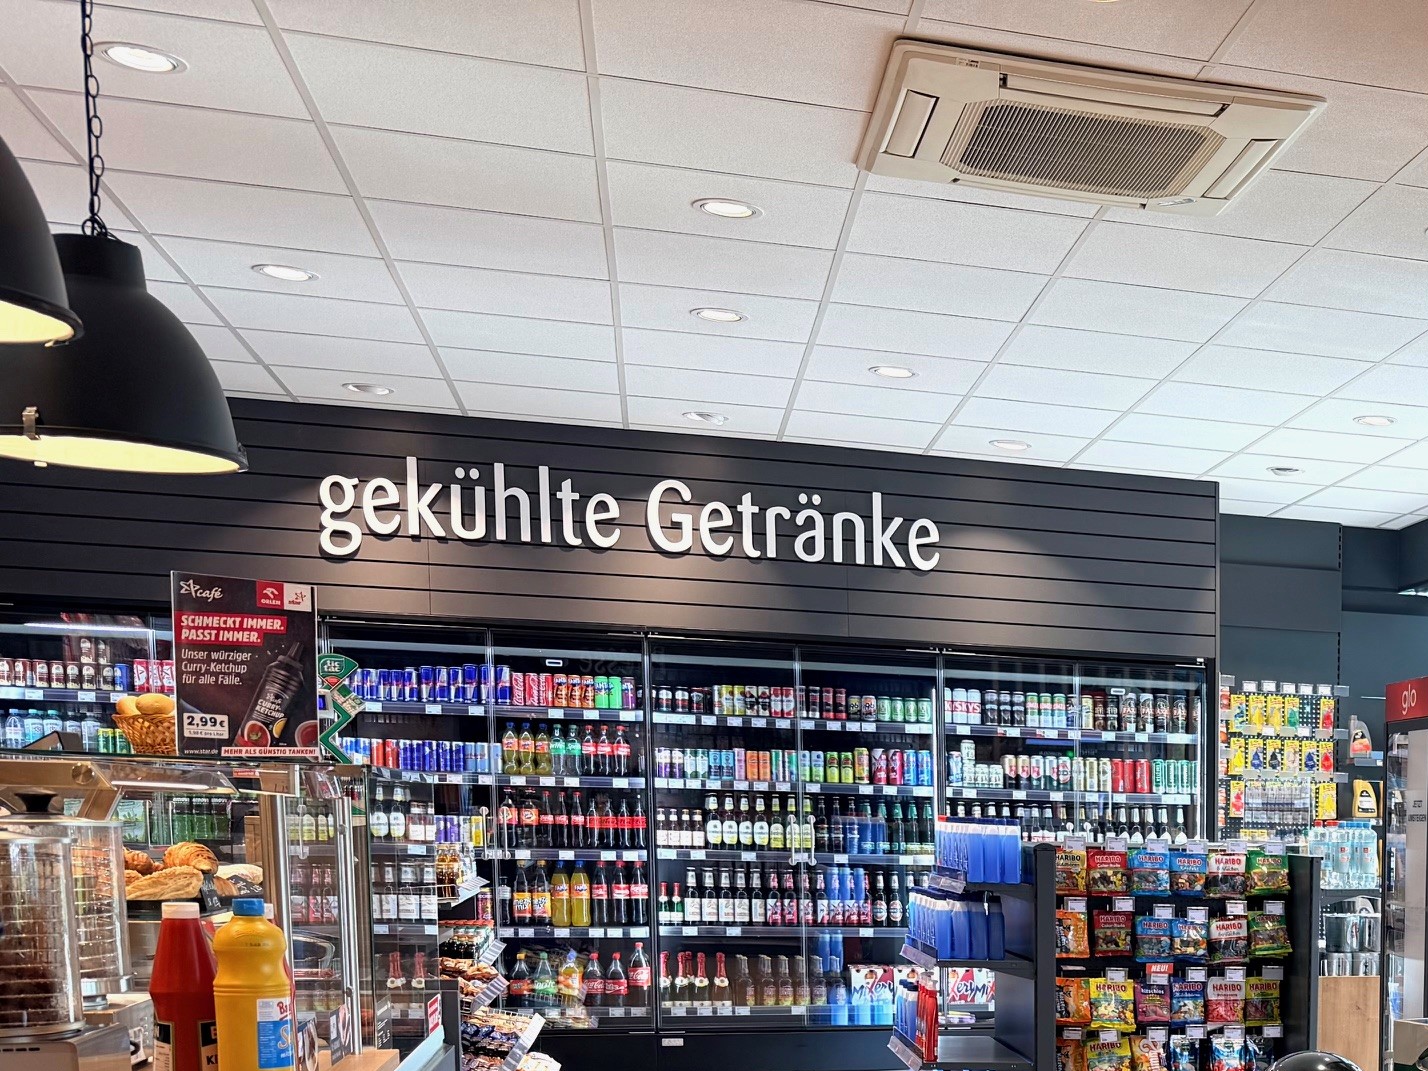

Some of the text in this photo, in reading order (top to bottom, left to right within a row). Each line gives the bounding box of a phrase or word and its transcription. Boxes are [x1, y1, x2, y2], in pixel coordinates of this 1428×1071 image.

[319, 456, 941, 570] gekühlte Getränke
[197, 587, 223, 602] café
[261, 598, 281, 606] ORLEN
[181, 615, 284, 630] SCHMECKT IMMER.
[181, 629, 261, 643] PASST IMMER.
[181, 648, 252, 662] Unser würziger
[181, 661, 247, 673] Curry-Ketchup
[326, 659, 339, 667] tic
[324, 665, 341, 673] tac
[182, 673, 242, 686] für alle Fälle.
[1401, 684, 1417, 715] glo
[257, 699, 282, 711] CURRY-
[255, 705, 285, 719] KETCHUP
[258, 747, 288, 755] GÜNSTIG
[1138, 855, 1164, 863] HARIBO
[1177, 858, 1202, 866] HARIBO
[1100, 915, 1126, 923] HARIBO
[1143, 921, 1168, 929] HARIBO
[1216, 922, 1242, 931] HARIBO
[1151, 964, 1168, 972] NEU!
[1096, 984, 1126, 992] HARIBO
[1173, 982, 1203, 992] HARIBO
[1212, 983, 1242, 992] HARIBO
[1249, 982, 1277, 991] HARIBO
[1089, 1041, 1122, 1052] HARIBO
